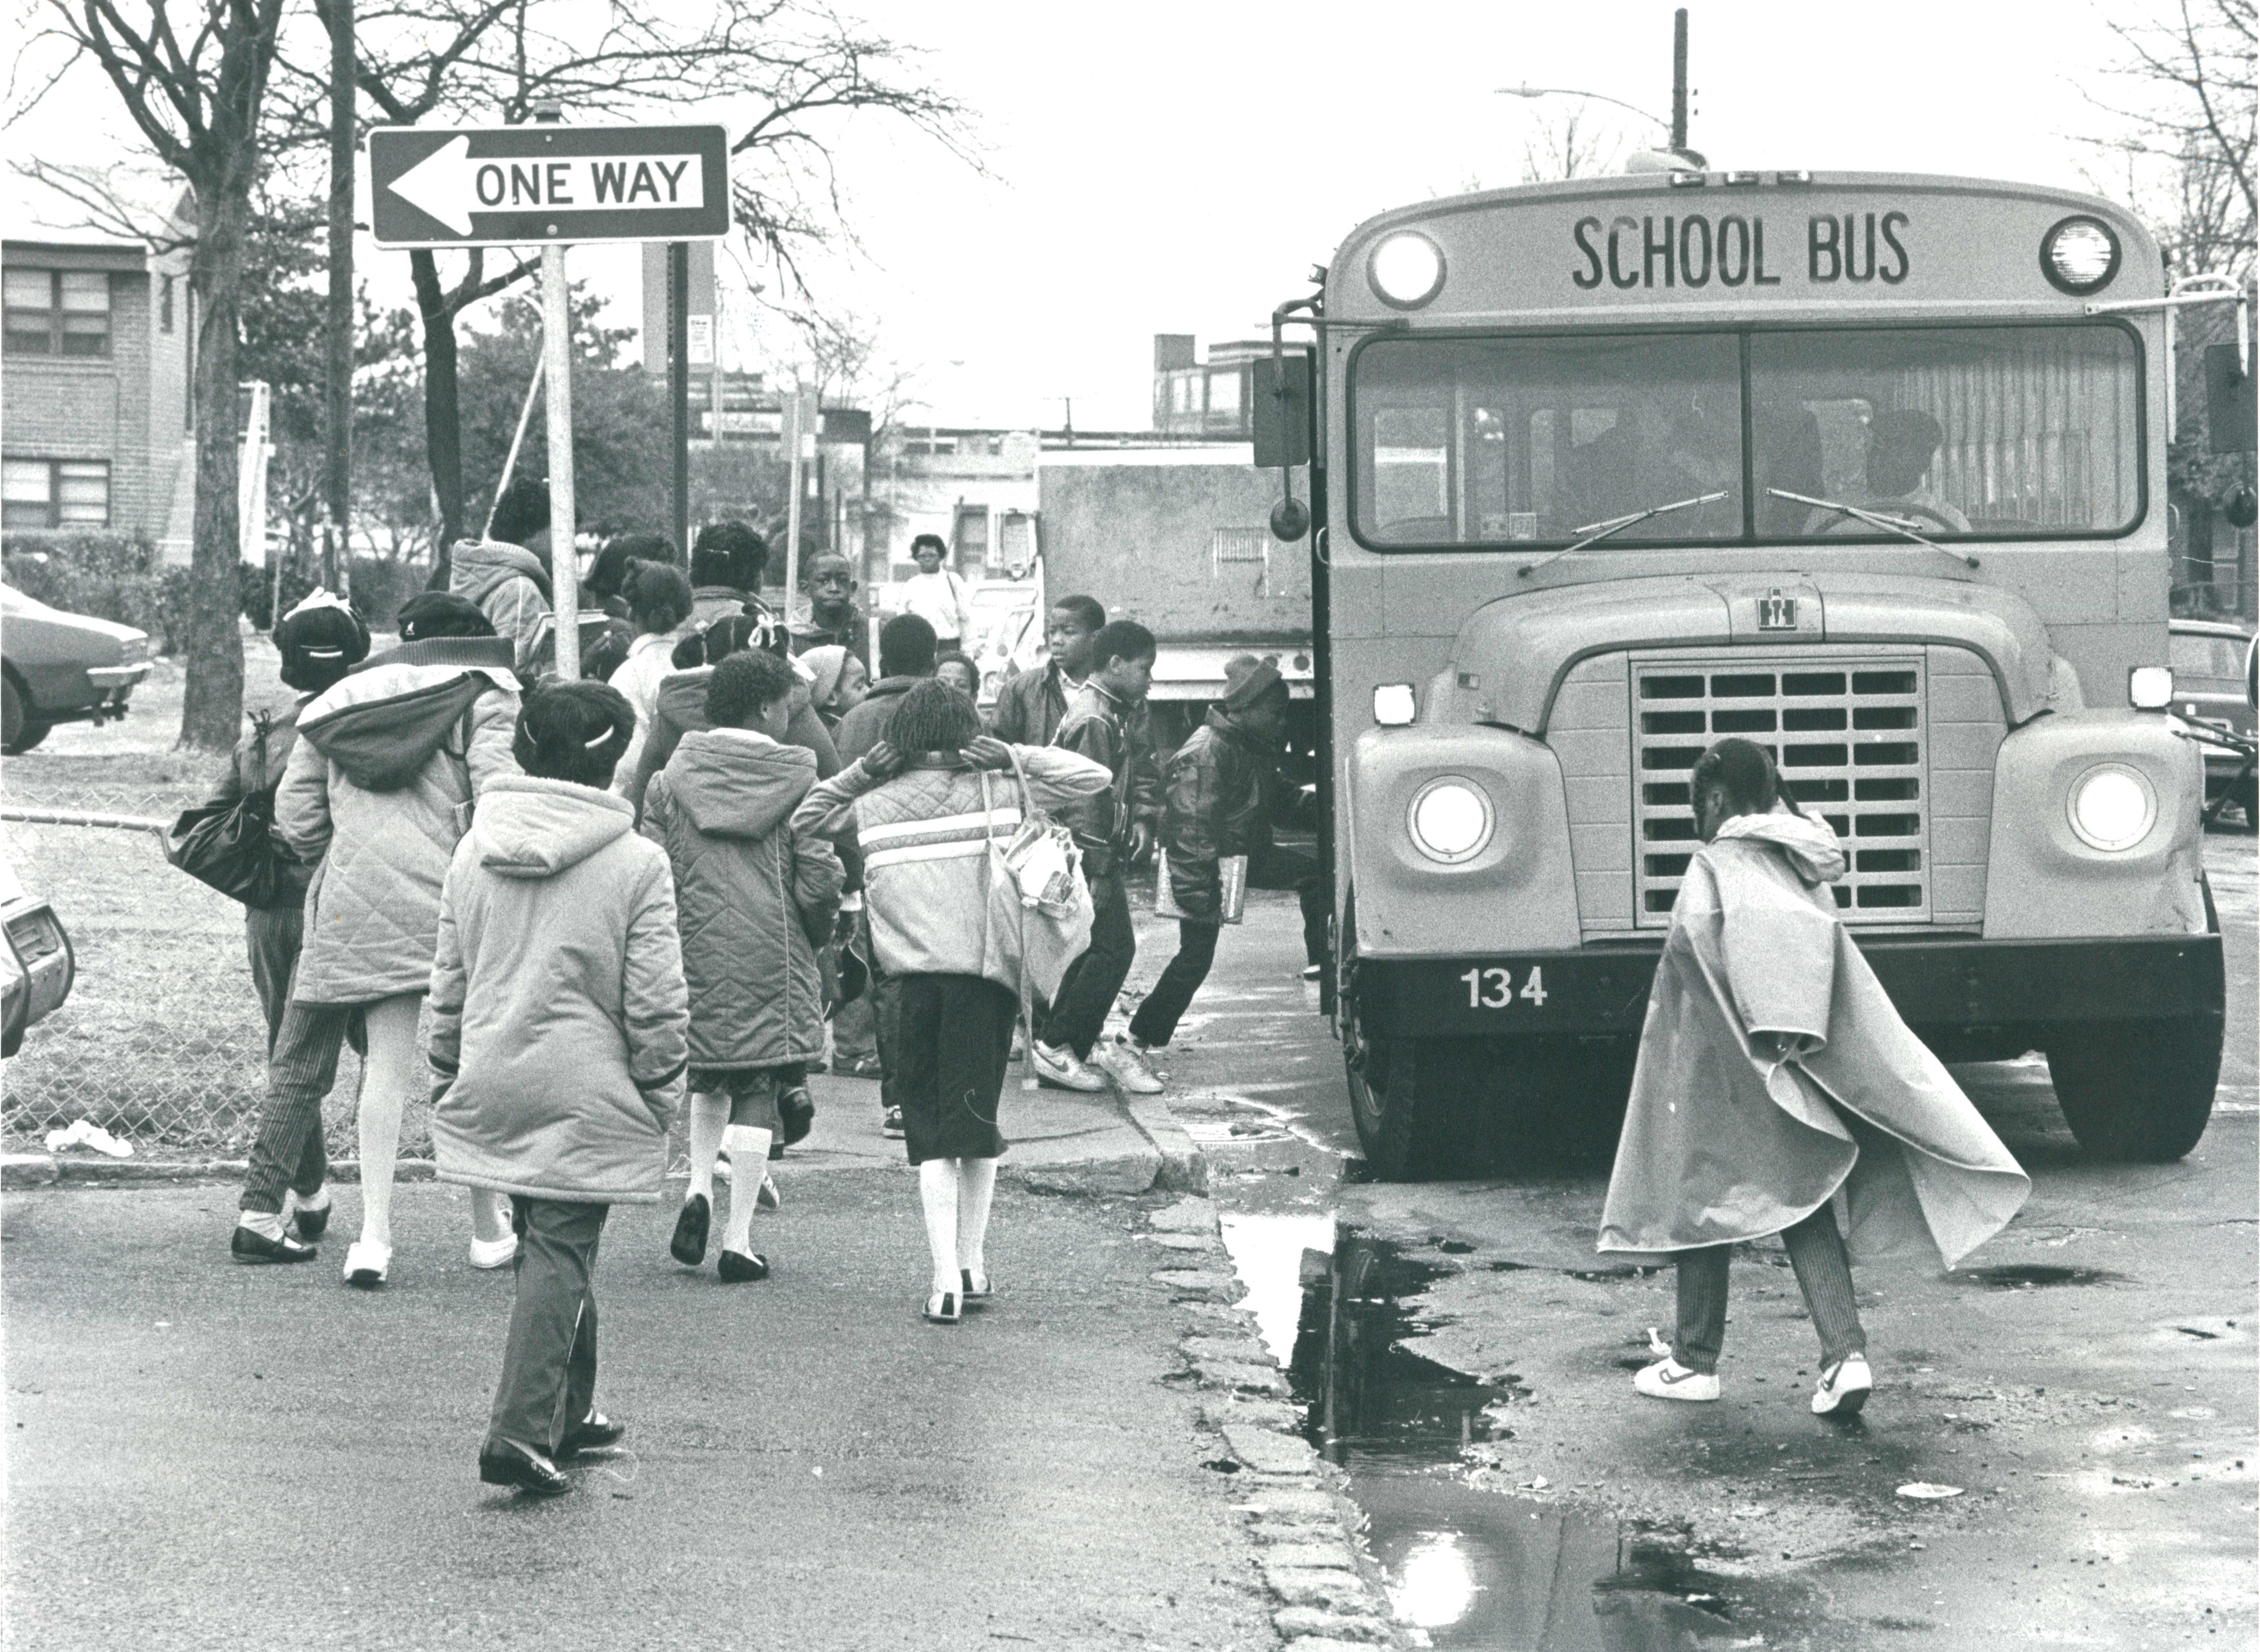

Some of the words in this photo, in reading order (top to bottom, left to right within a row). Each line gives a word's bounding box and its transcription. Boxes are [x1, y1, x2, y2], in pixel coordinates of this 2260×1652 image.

[476, 163, 573, 207] ONE
[591, 161, 689, 203] WAY
[1572, 214, 1782, 290] SCHOOL
[1808, 211, 1909, 285] BUS
[1460, 966, 1548, 1008] 134
